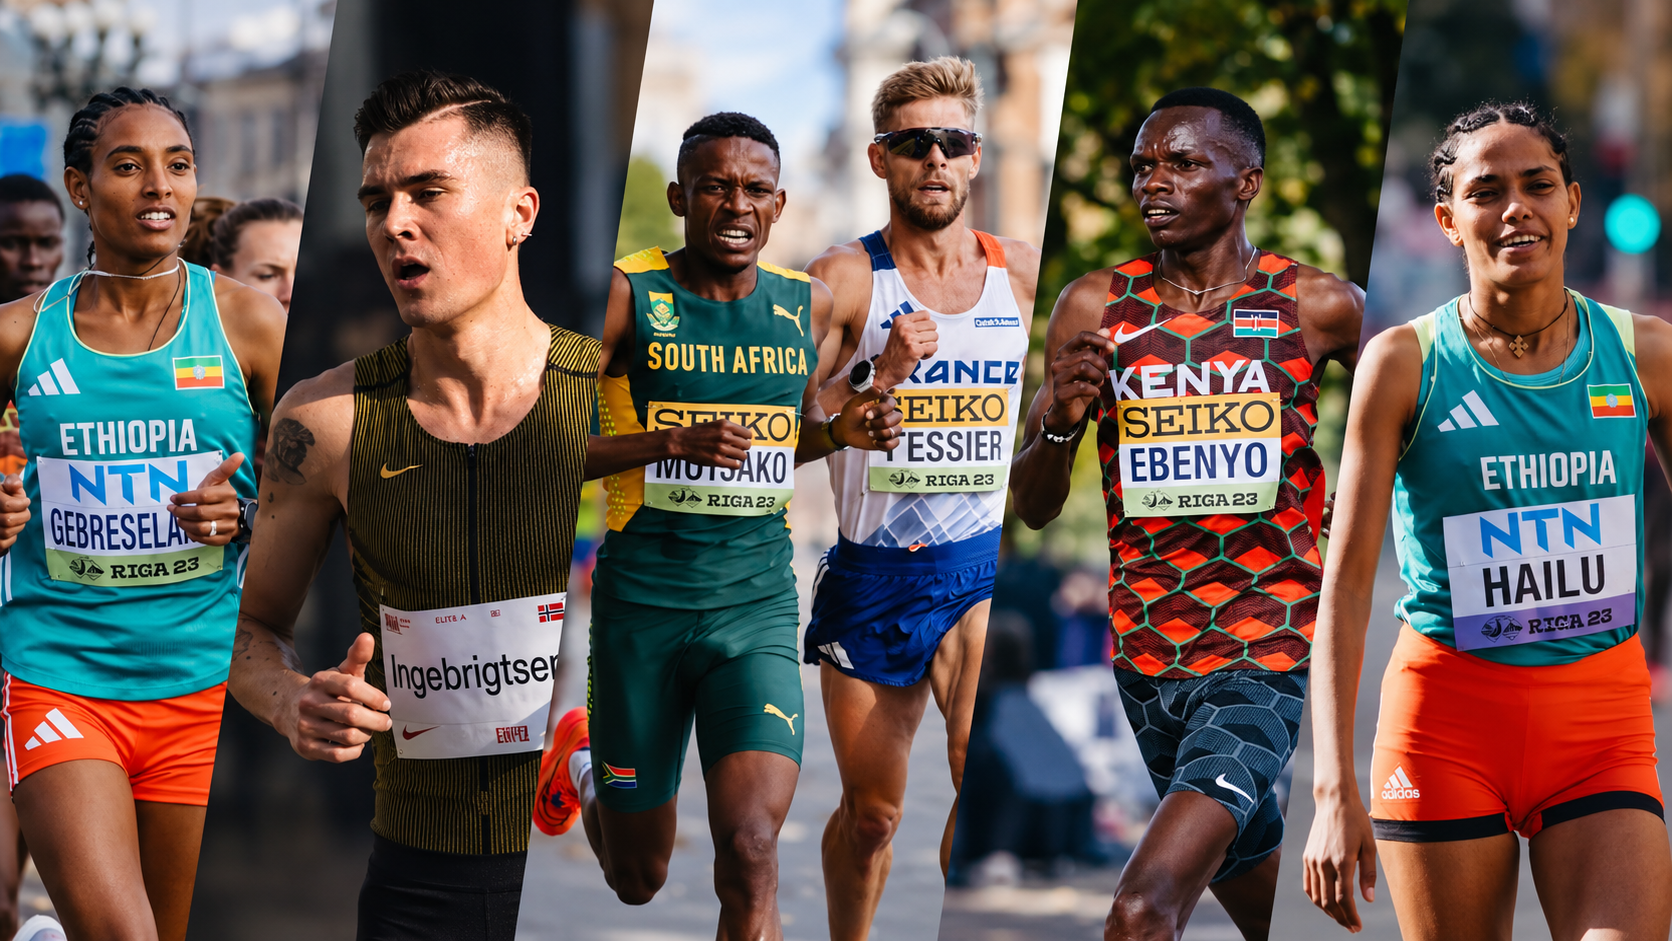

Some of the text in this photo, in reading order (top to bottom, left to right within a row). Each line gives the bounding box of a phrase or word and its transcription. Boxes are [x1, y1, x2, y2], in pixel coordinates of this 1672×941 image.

[647, 342, 808, 376] SOUTH AFRICA
[908, 360, 1020, 384] ANCE
[1109, 359, 1271, 401] KENYA
[59, 418, 198, 456] ETHIOPIA
[1123, 400, 1275, 438] SEIKO
[1129, 442, 1268, 482] EBENYO
[1479, 450, 1617, 491] ETHIOPIA
[68, 460, 189, 506] NTN
[925, 474, 994, 487] RIGA 23
[707, 494, 776, 509] RIGA 23
[1177, 492, 1258, 508] RIGA 23
[1479, 503, 1601, 559] NTN
[110, 557, 200, 579] RIGA 23
[1482, 554, 1605, 608] HAILU
[1528, 608, 1613, 635] RIGA 23
[1381, 787, 1421, 800] adidas
